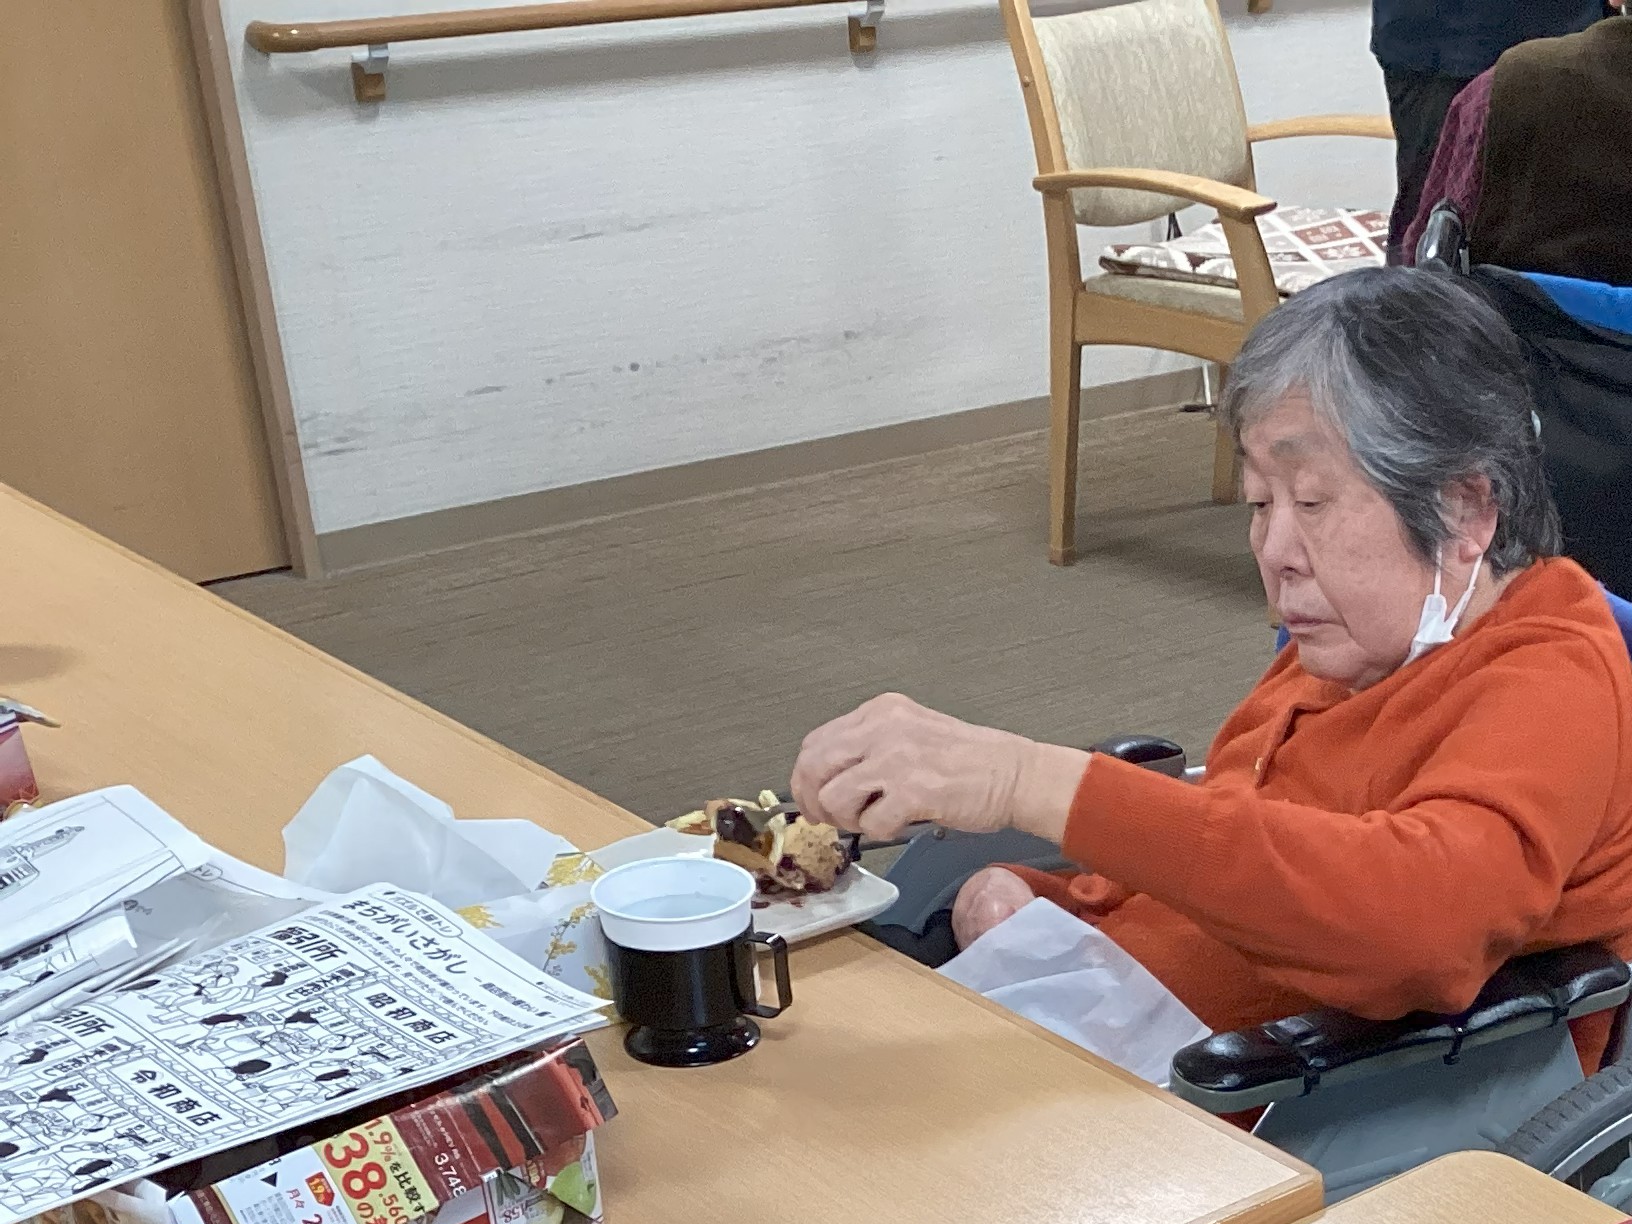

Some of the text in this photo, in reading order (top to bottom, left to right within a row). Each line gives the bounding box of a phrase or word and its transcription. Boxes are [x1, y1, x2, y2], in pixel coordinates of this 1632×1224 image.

[341, 899, 468, 975] まちがいさがし
[364, 991, 458, 1044] 昭和商店
[130, 1068, 223, 1127] 令和商店
